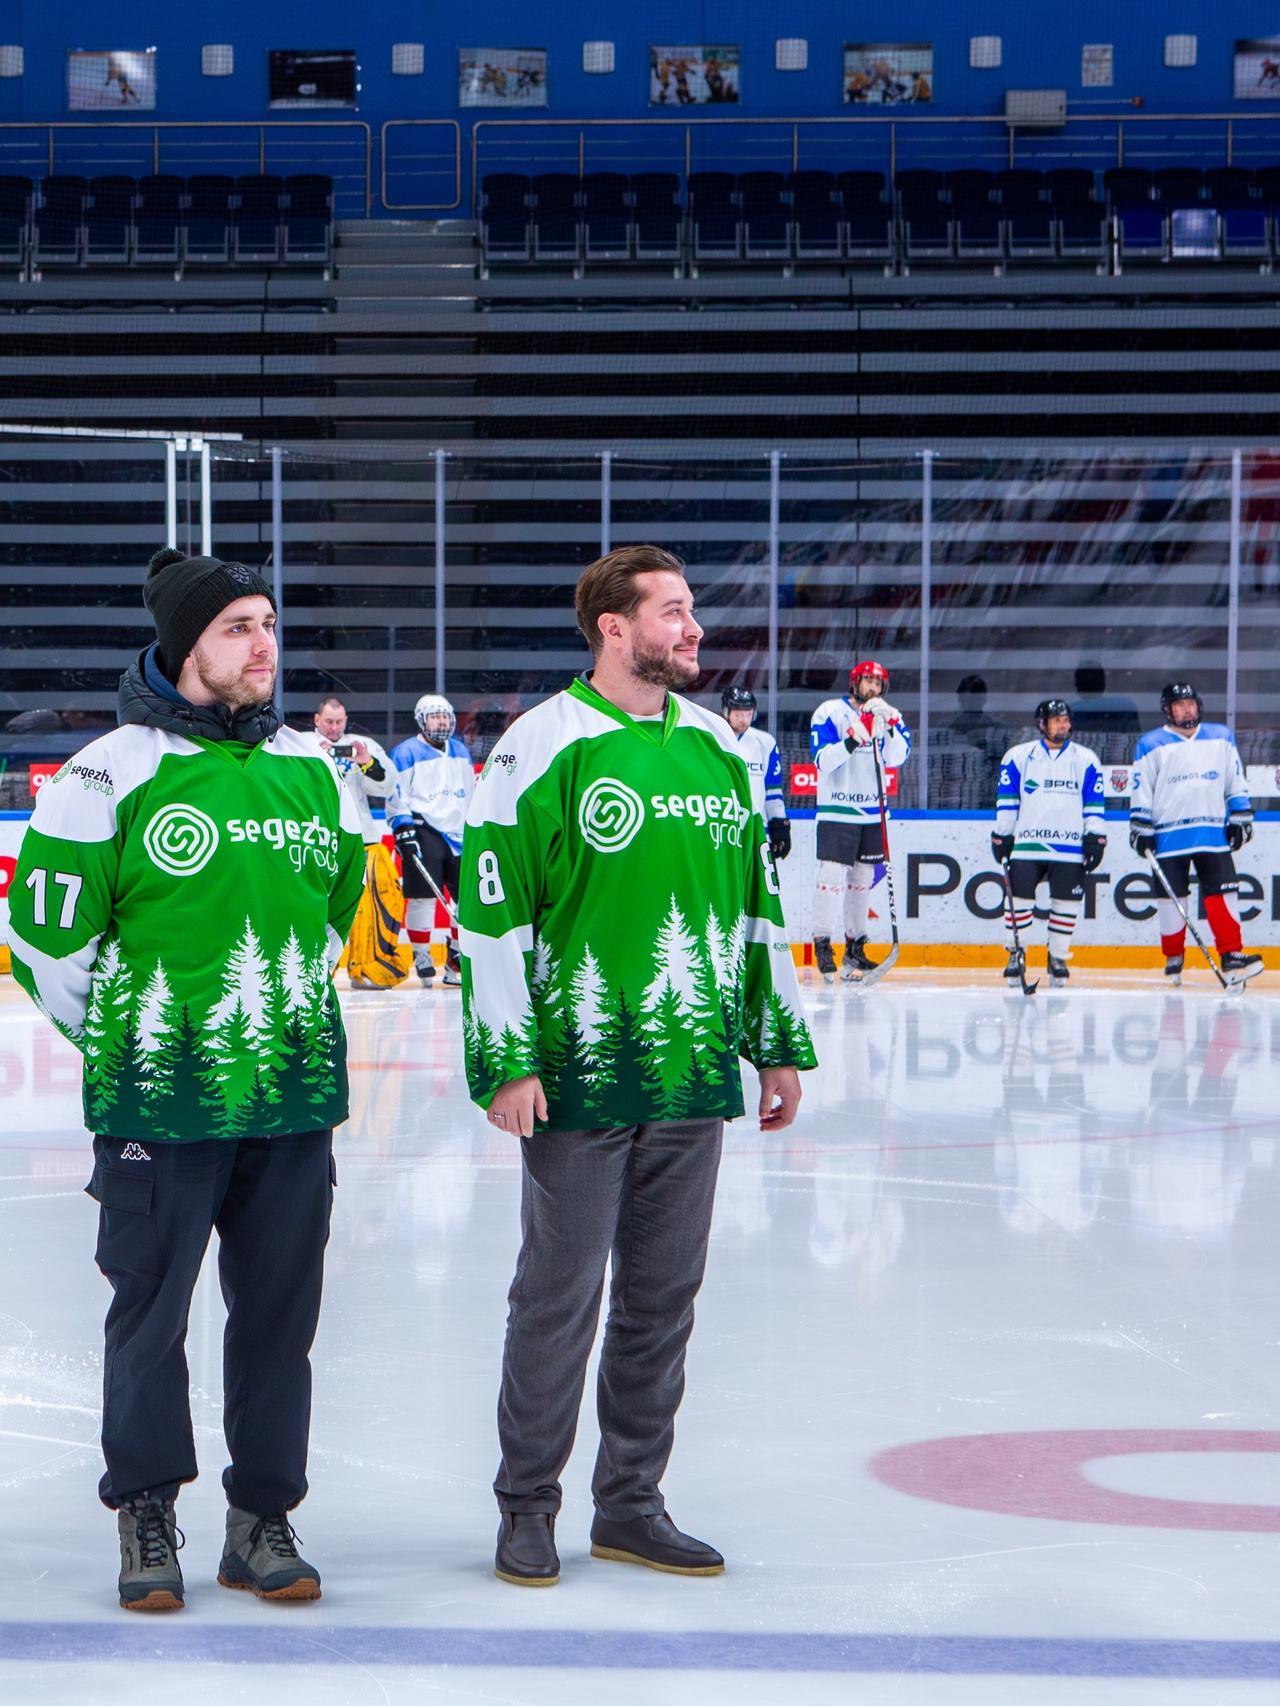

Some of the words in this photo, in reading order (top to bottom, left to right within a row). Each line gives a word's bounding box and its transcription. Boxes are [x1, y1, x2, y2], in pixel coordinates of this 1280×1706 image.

[83, 778, 115, 798] group
[25, 867, 84, 930] 17
[477, 848, 507, 906] 8
